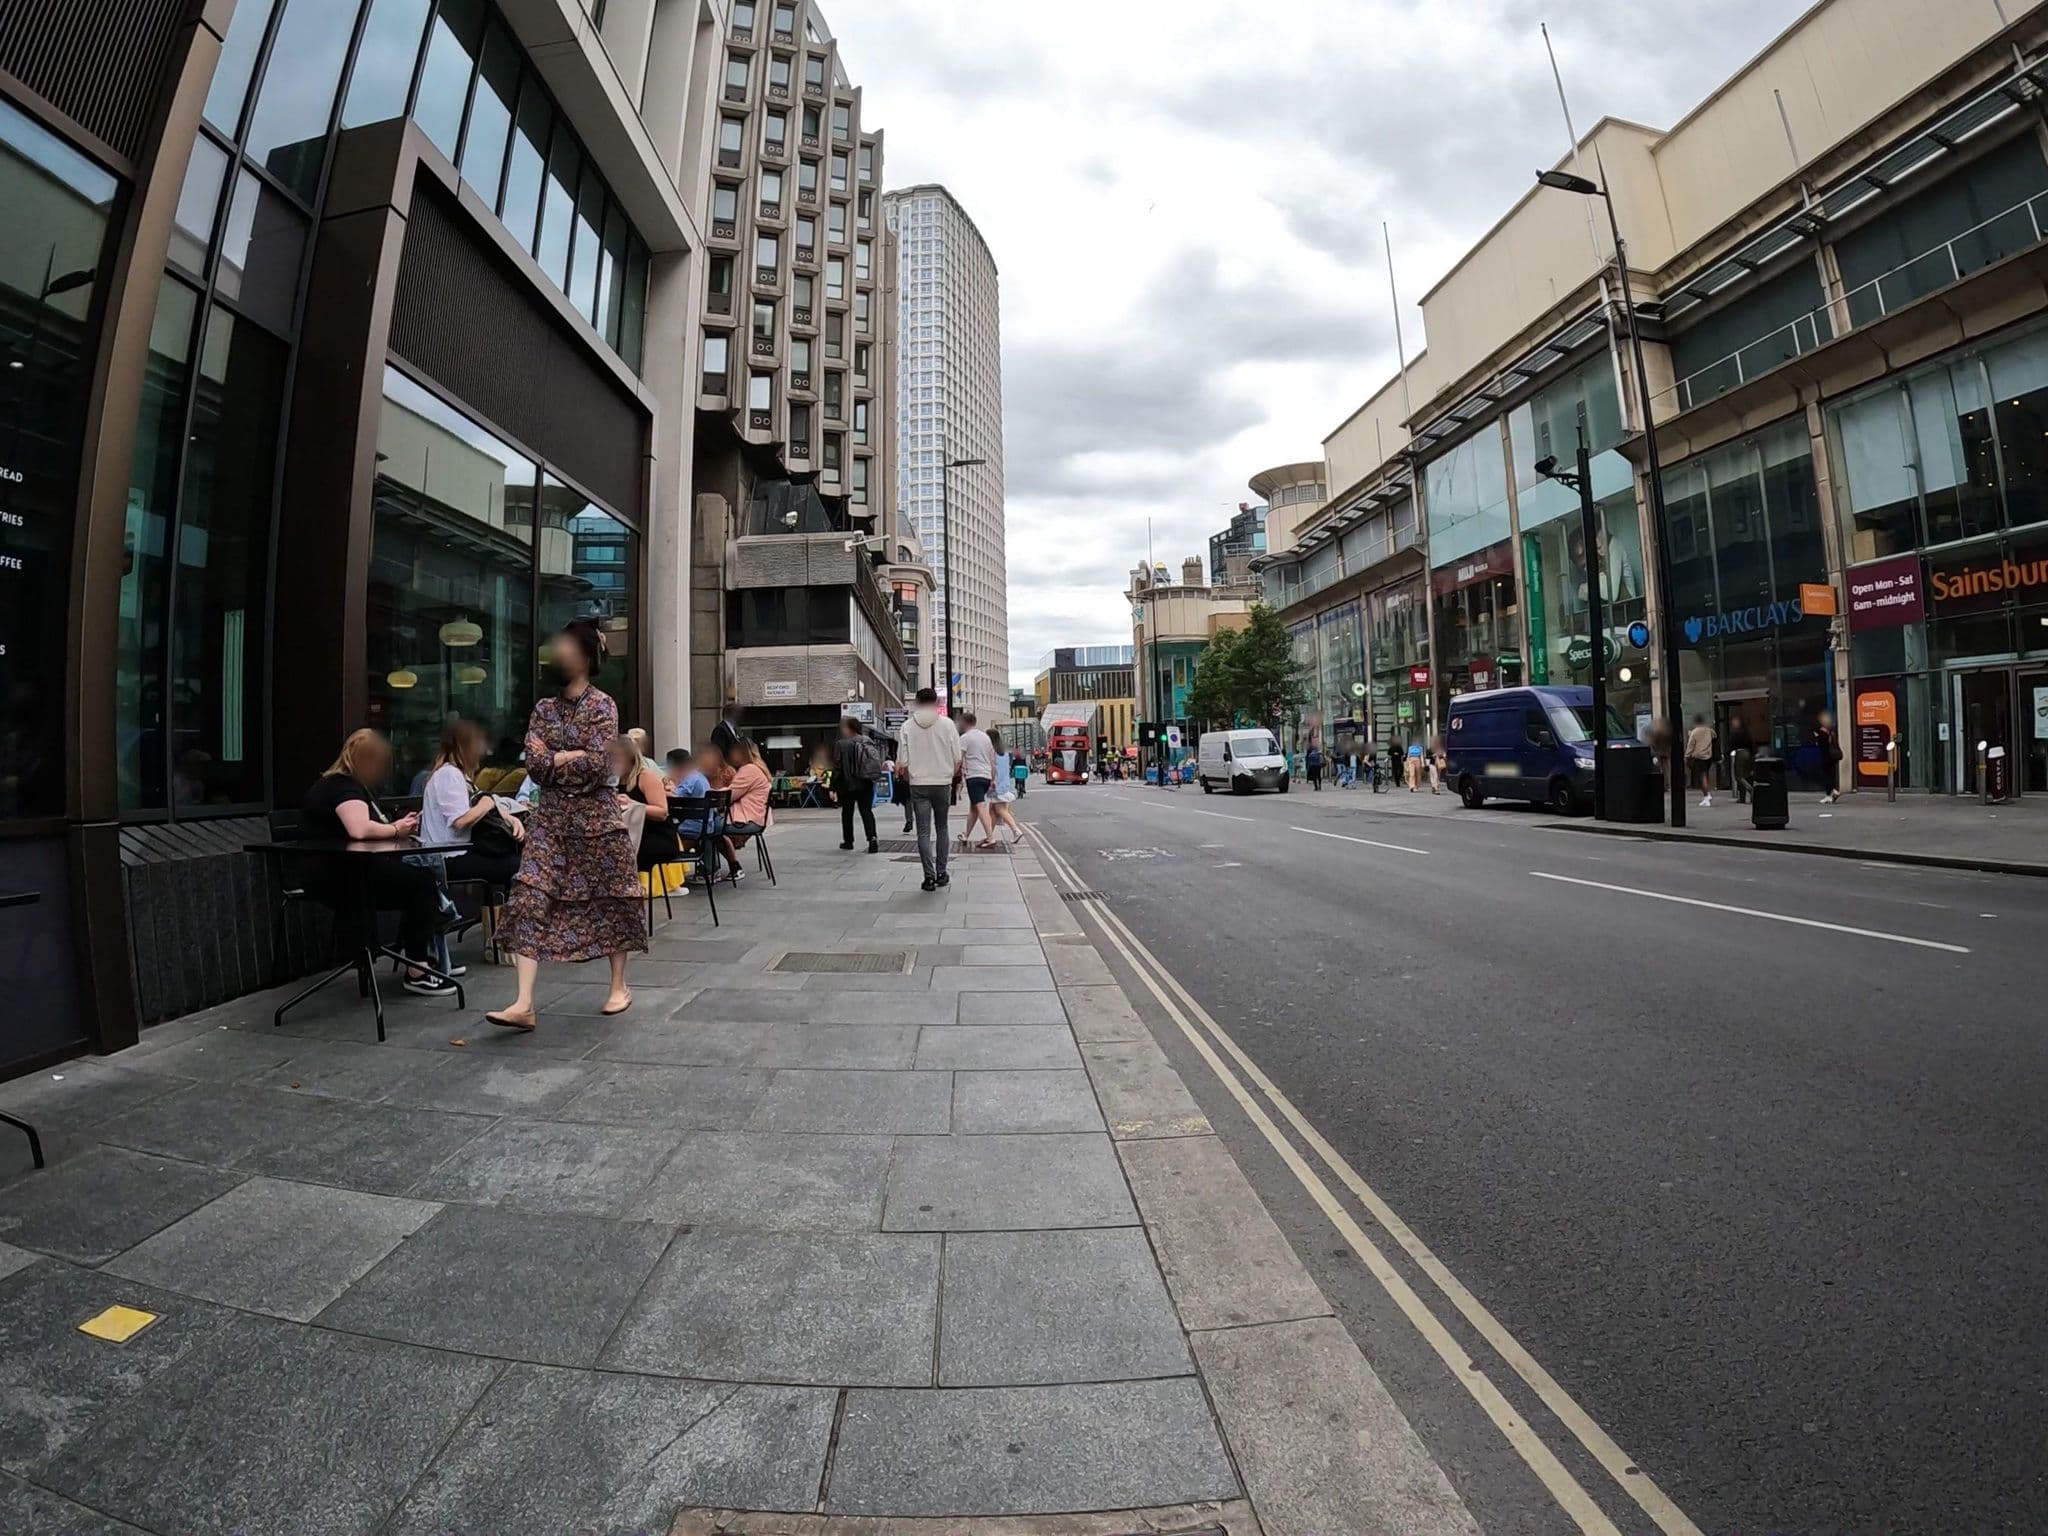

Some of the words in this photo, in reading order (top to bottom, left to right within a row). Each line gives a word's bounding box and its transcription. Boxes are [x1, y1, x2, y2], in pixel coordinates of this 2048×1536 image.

[1852, 584, 1874, 596] Open
[1875, 580, 1893, 590] Mon
[1898, 574, 1914, 586] Sat
[1706, 598, 1804, 638] BARCLAYS
